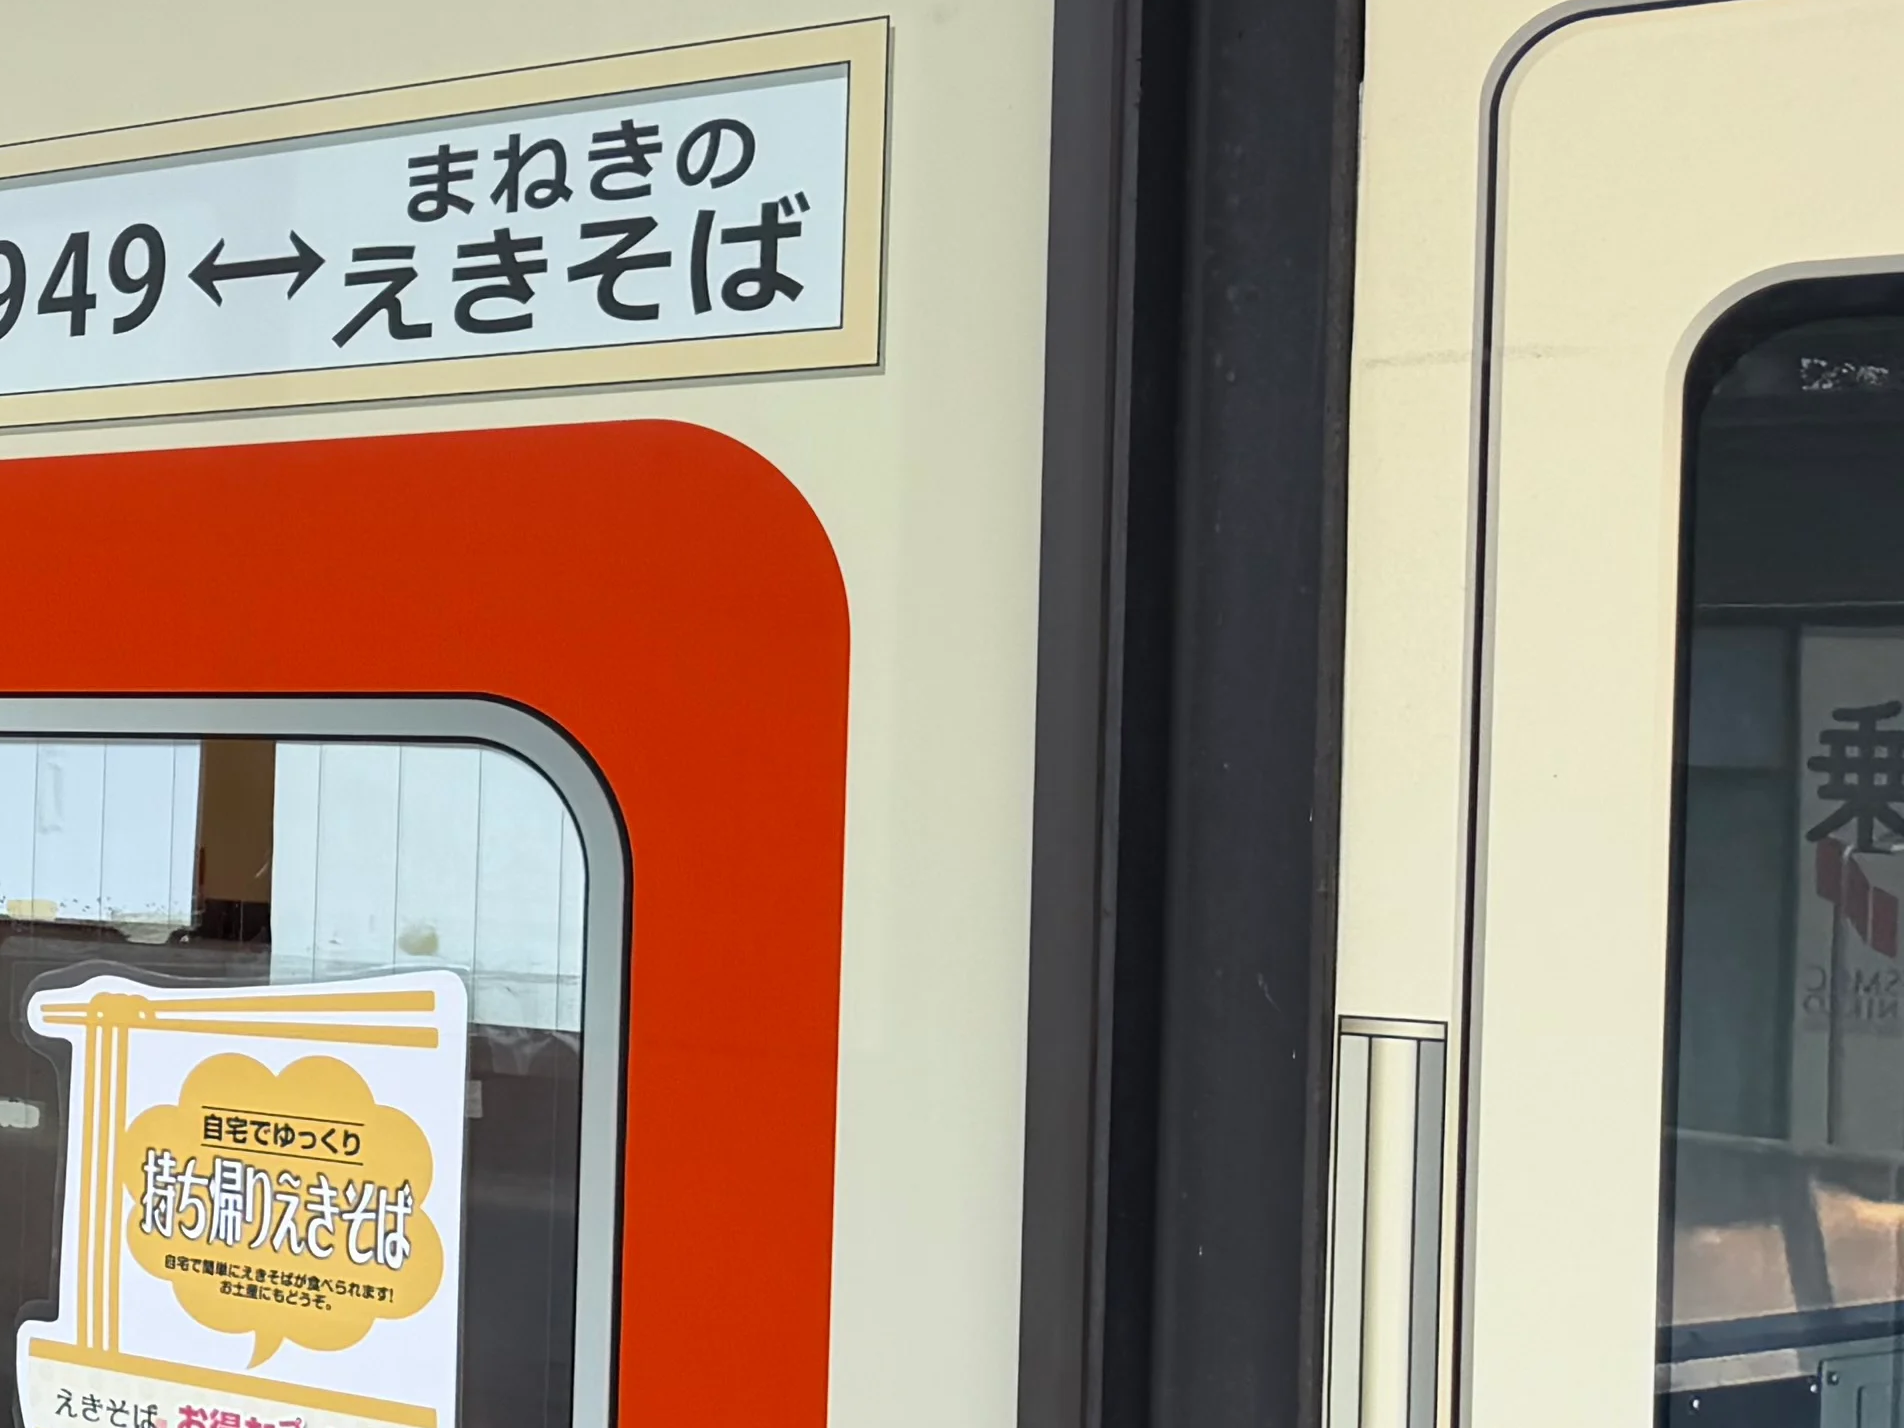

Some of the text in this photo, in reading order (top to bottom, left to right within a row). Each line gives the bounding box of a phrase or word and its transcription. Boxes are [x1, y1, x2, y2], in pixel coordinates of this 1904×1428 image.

[407, 117, 756, 223] まねきの
[333, 193, 813, 348] えきそば
[202, 1113, 361, 1157] 自宅でゆっくり
[141, 1149, 413, 1271] 持ち帰りえきそば
[165, 1254, 394, 1303] 自宅で簡単にえきそばが食べられます!
[220, 1281, 332, 1311] お土産にもどうぞ。
